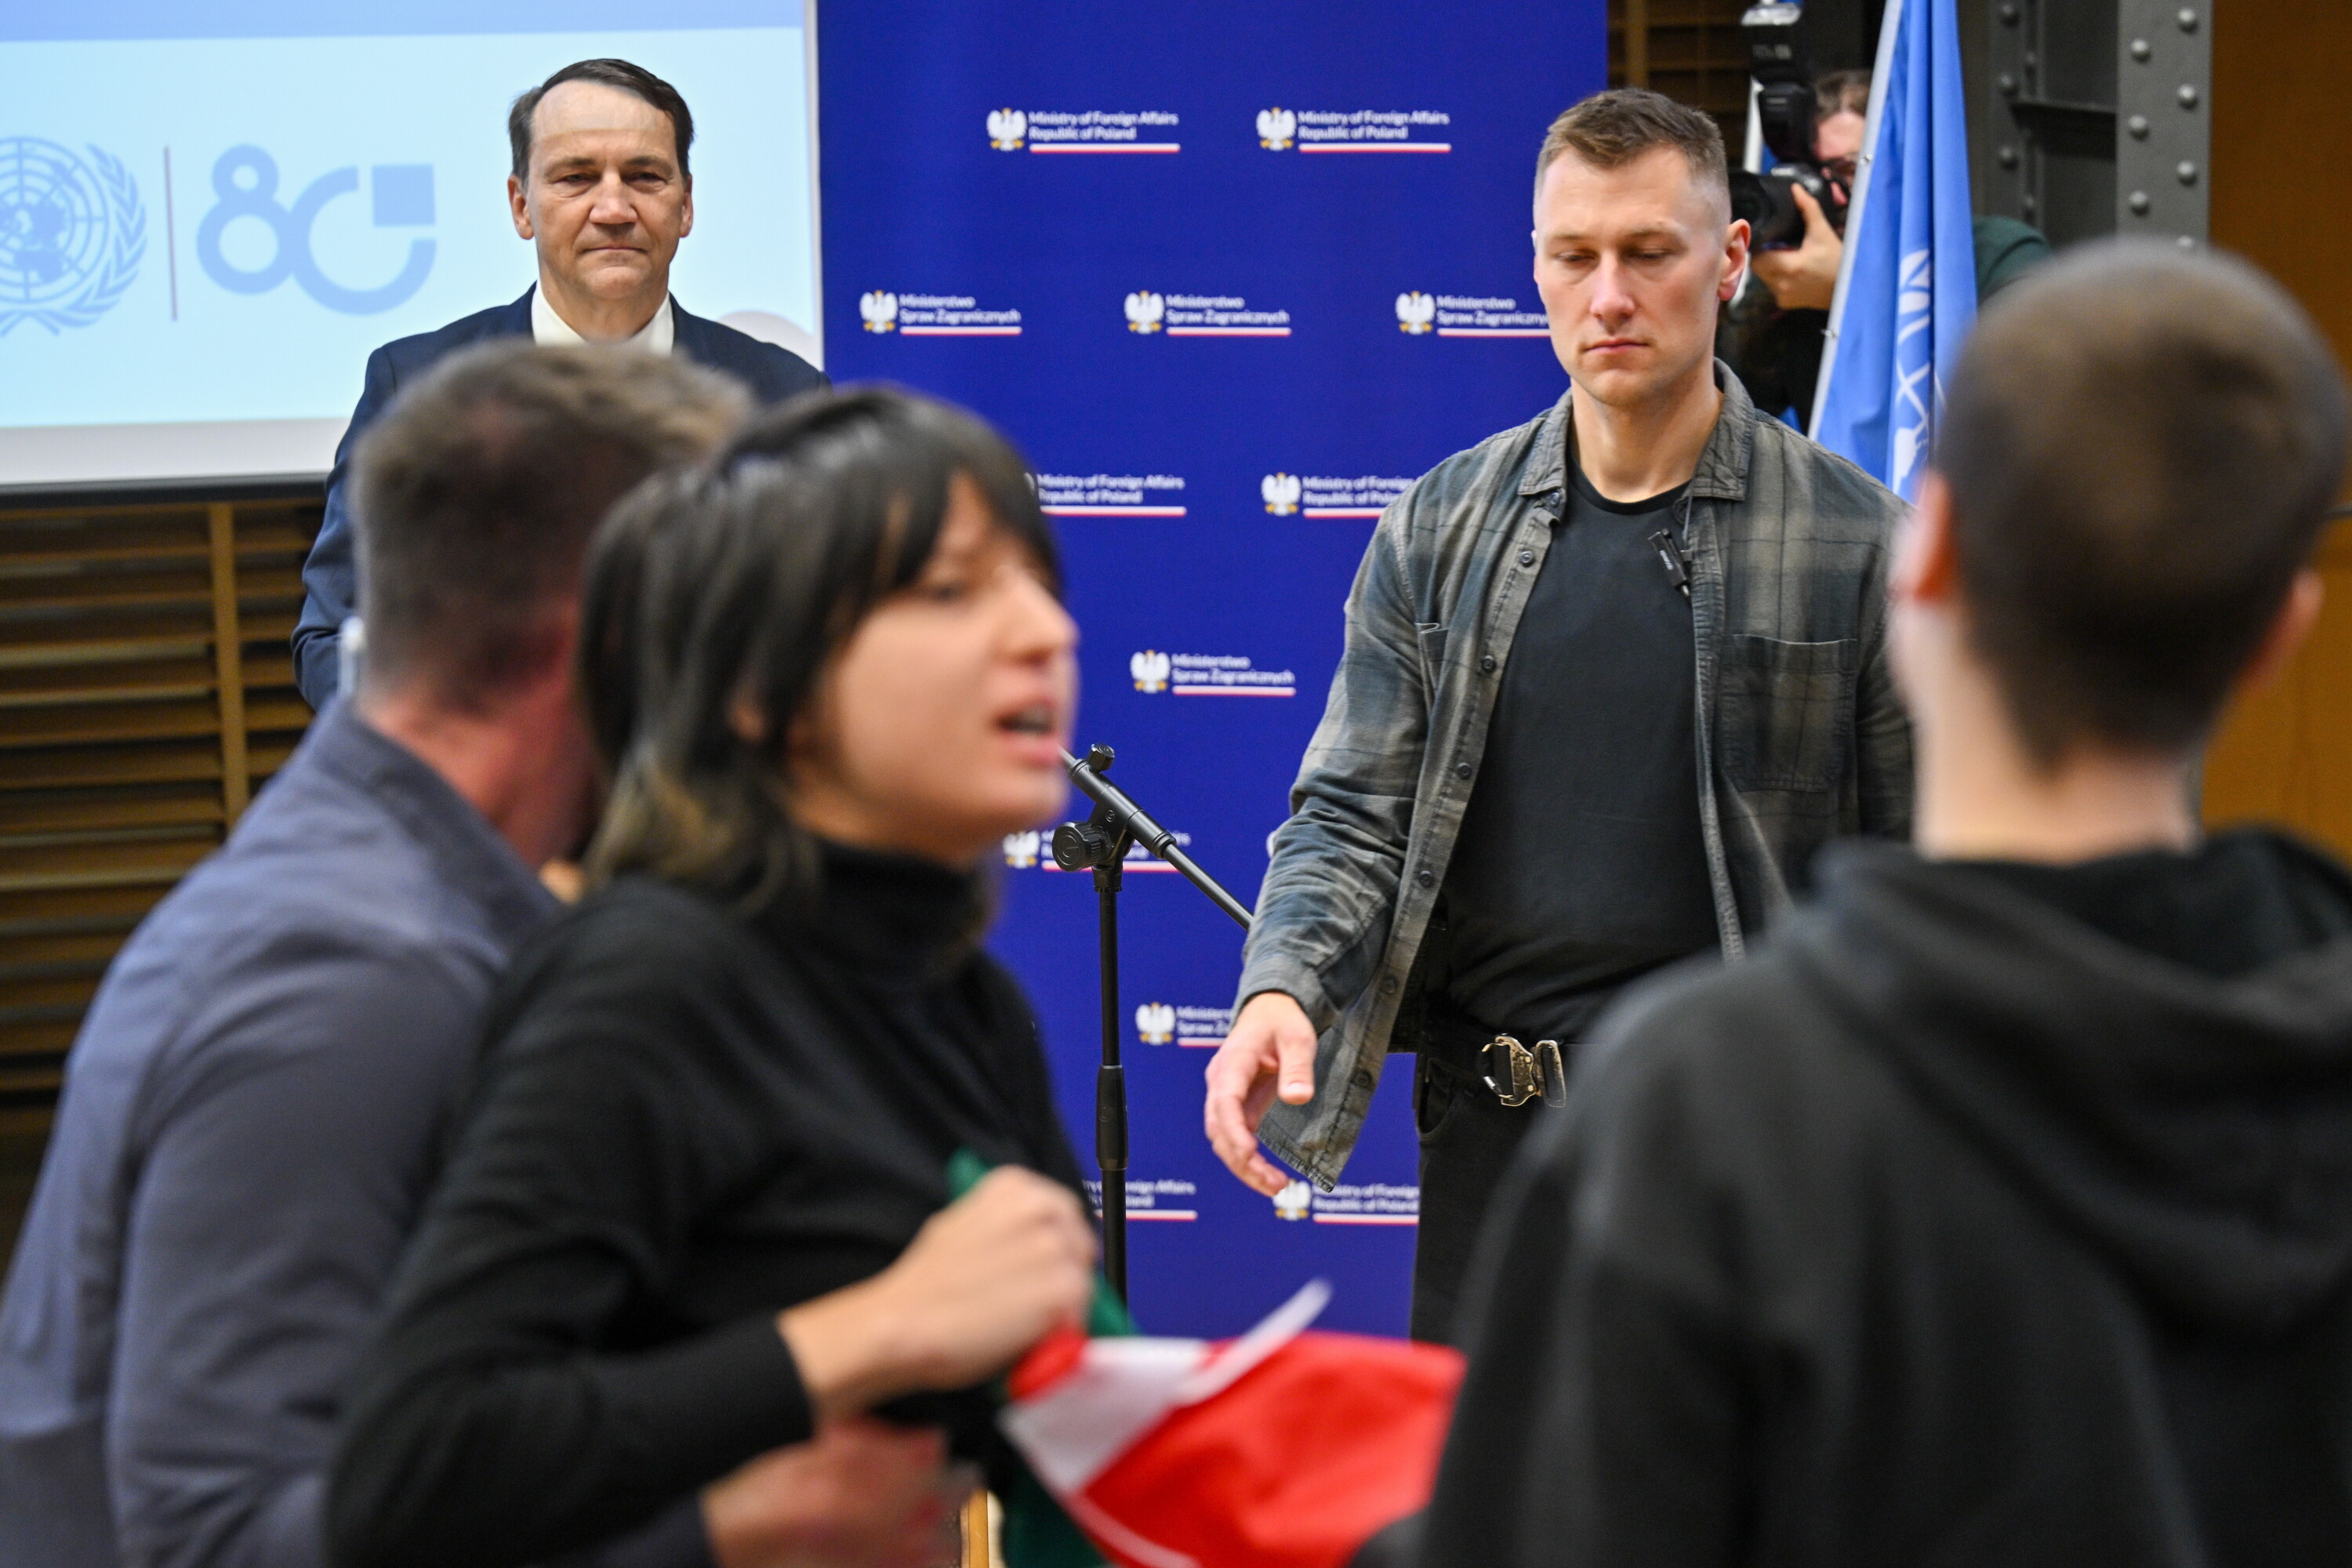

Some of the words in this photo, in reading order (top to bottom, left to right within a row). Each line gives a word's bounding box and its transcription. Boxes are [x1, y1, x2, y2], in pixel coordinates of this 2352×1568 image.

[1029, 111, 1077, 127] Ministry
[1078, 111, 1093, 125] of
[1093, 111, 1138, 127] Foreign
[1139, 111, 1179, 125] Affairs
[1298, 111, 1348, 126] Ministry
[1348, 110, 1363, 125] of
[1364, 110, 1410, 126] Foreign
[1410, 111, 1450, 125] Affairs
[1029, 126, 1079, 142] Republic
[1080, 126, 1094, 140] of
[1094, 126, 1136, 140] Poland
[1298, 125, 1350, 141] Republic
[1350, 125, 1365, 140] of
[1366, 125, 1408, 140] Poland
[899, 294, 976, 309] Ministerstwo
[1166, 294, 1245, 309] Ministerstwo
[1436, 295, 1516, 310] Ministerstwo
[899, 308, 935, 325] Spraw
[935, 308, 1022, 325] Zagranicznych
[1166, 309, 1203, 325] Spraw
[1204, 308, 1290, 325] Zagranicznych
[1437, 310, 1473, 325] Spraw
[1474, 310, 1549, 327] Zagraniczny
[1084, 474, 1099, 489] of
[1099, 474, 1144, 490] Foreign
[1144, 474, 1185, 490] Affairs
[1302, 475, 1352, 492] Ministry
[1353, 475, 1368, 491] of
[1085, 488, 1100, 503] of
[1101, 488, 1143, 504] Poland
[1303, 490, 1354, 506] Republic
[1355, 490, 1369, 505] of
[1171, 653, 1251, 670] Ministerstwo
[1172, 668, 1209, 684] Spraw
[1210, 668, 1295, 685] Zagranicznych
[1177, 1021, 1214, 1036] Spraw
[1155, 1179, 1197, 1196] Affairs
[1312, 1196, 1362, 1213] Republic
[1362, 1197, 1376, 1213] of
